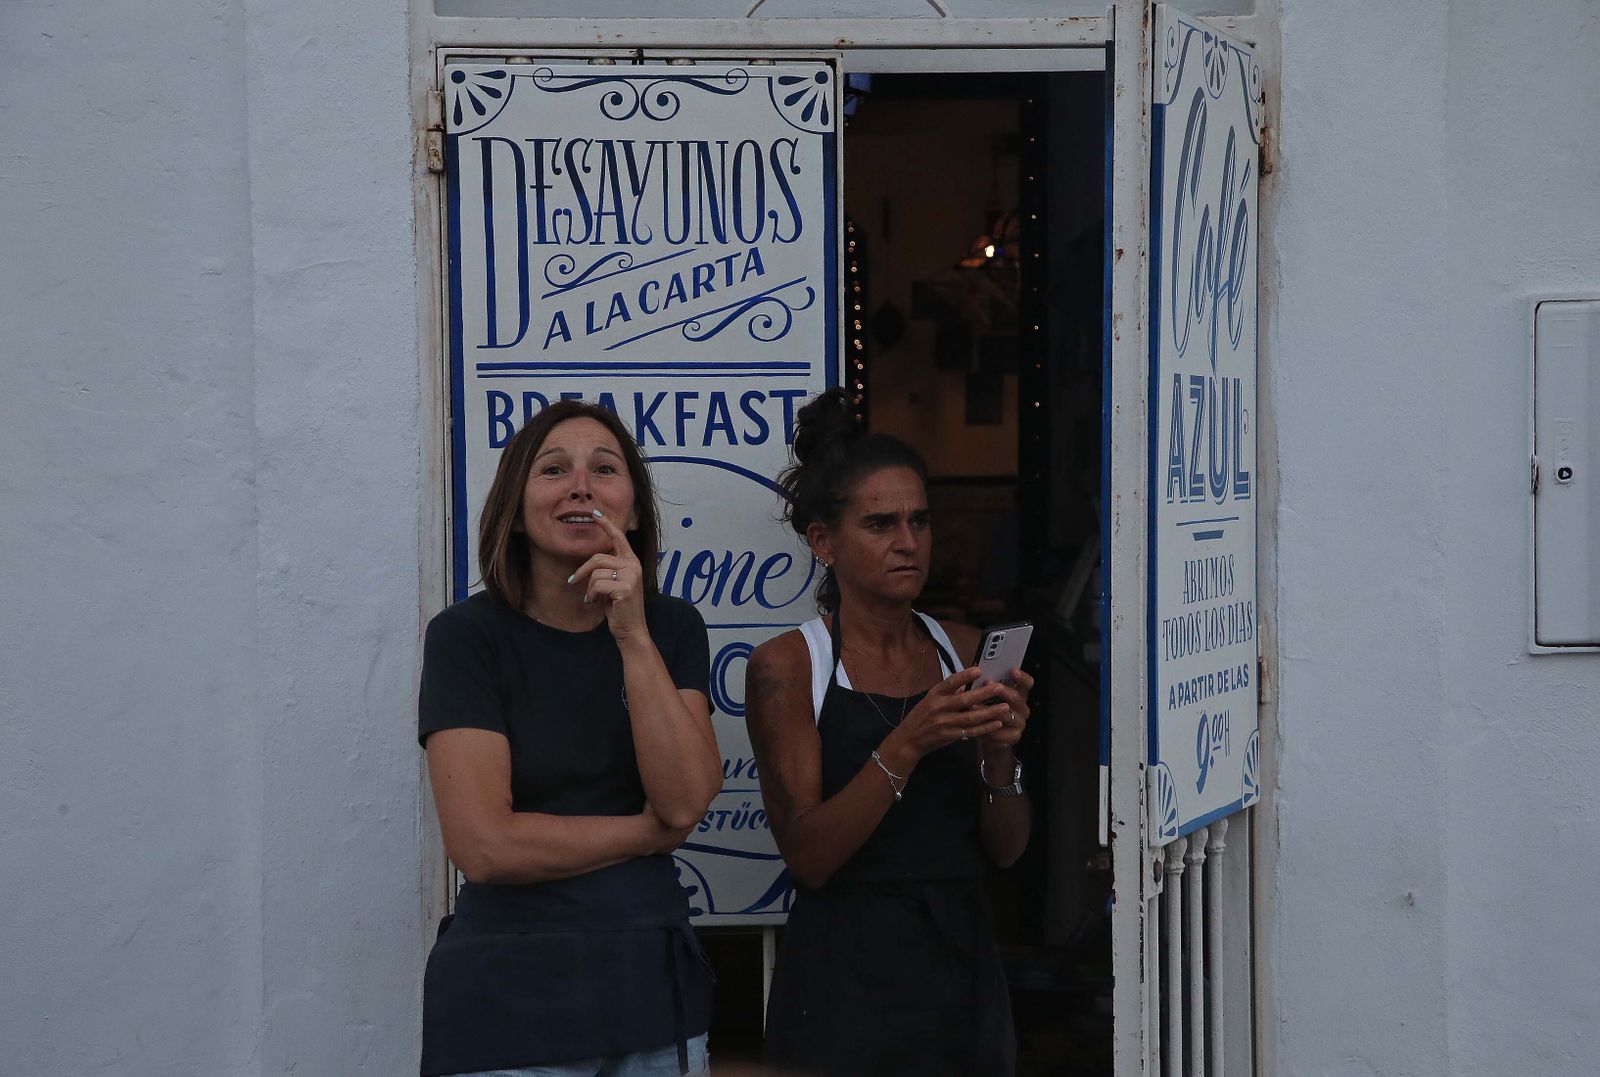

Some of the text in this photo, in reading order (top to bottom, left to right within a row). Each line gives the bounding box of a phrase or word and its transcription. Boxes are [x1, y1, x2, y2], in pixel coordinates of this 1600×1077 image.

[472, 137, 804, 349] DESAYUNOS
[1170, 86, 1252, 374] Café
[543, 246, 766, 350] A LA CARTA
[1166, 373, 1251, 506] AZUL
[1162, 598, 1254, 662] TODOS LOS DÍAS
[1183, 554, 1235, 604] ABRIMOS
[1168, 663, 1250, 711] A PARTIR DE LAS
